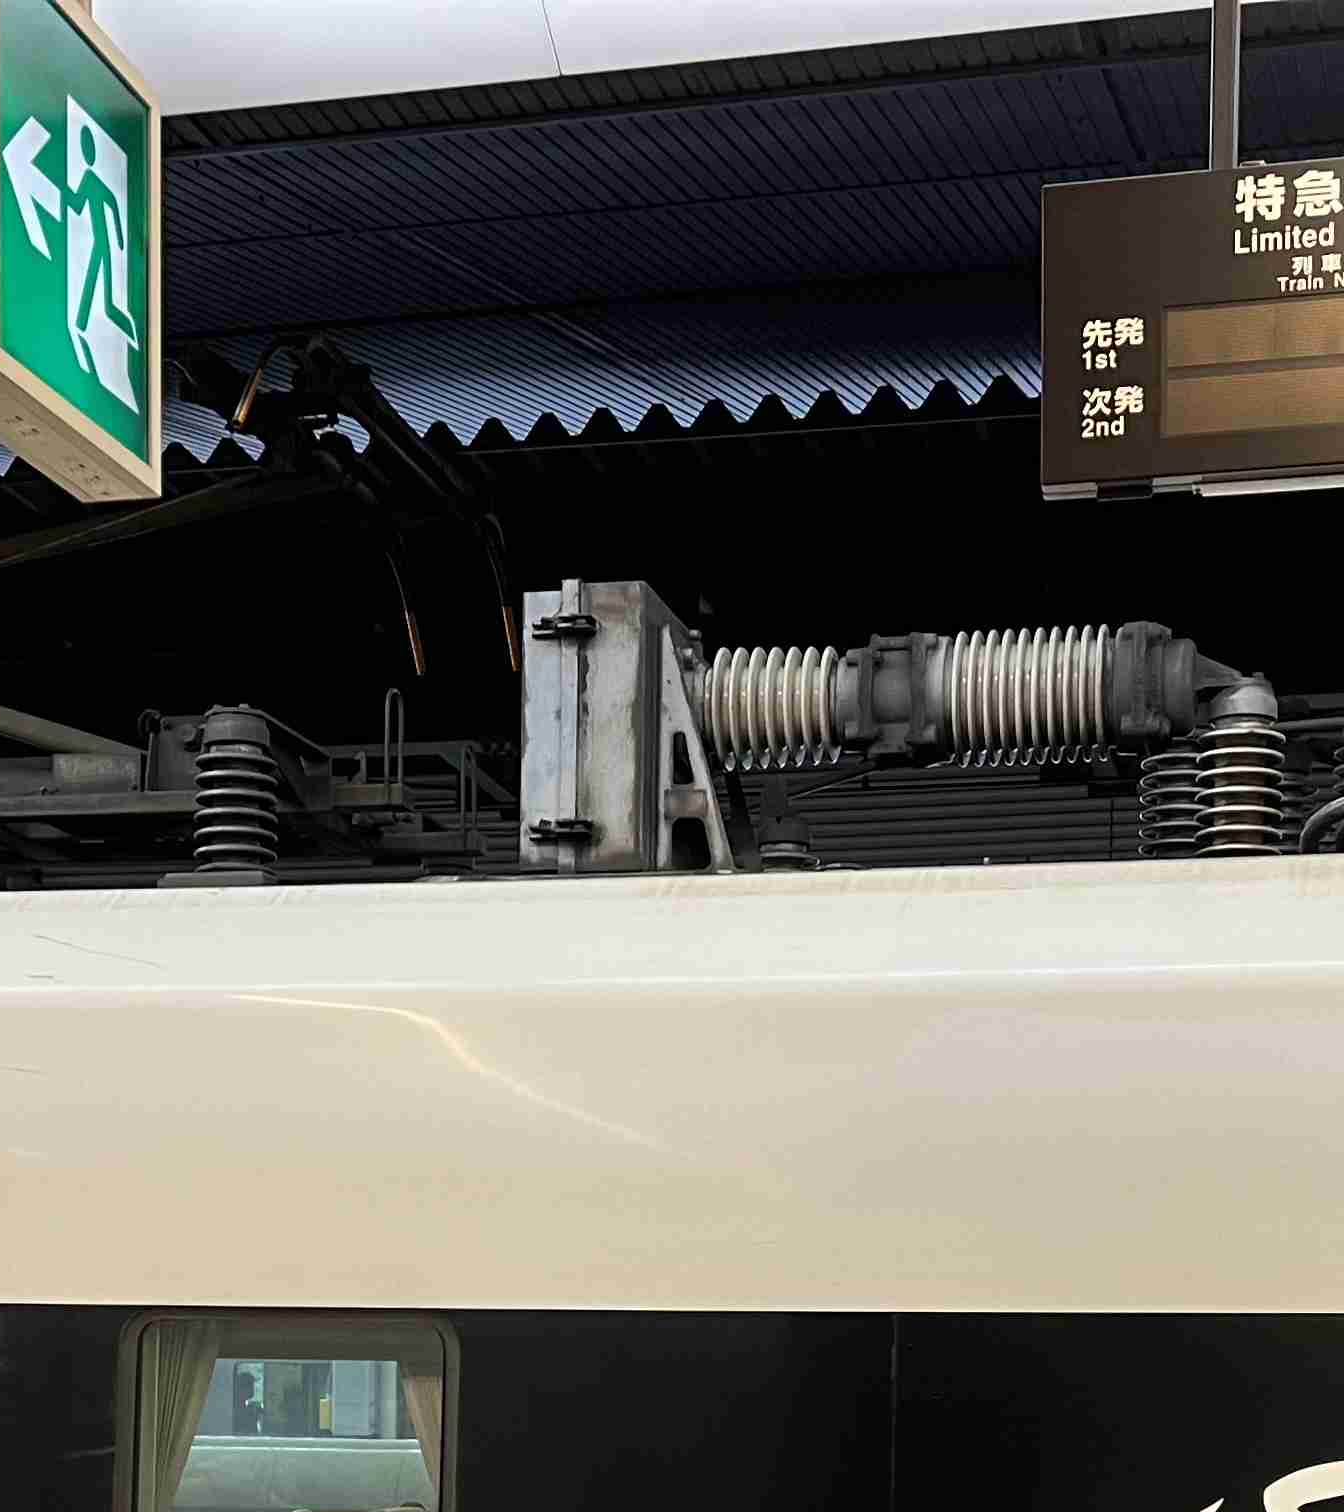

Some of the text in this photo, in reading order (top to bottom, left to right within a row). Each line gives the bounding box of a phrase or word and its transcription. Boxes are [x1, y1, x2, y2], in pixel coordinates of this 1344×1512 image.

[1234, 223, 1336, 255] Limited
[1277, 276, 1324, 292] Train
[1082, 317, 1144, 349] 先発
[1081, 349, 1117, 370] 1st
[1082, 385, 1144, 416] 次発
[1081, 416, 1125, 438] 2nd
